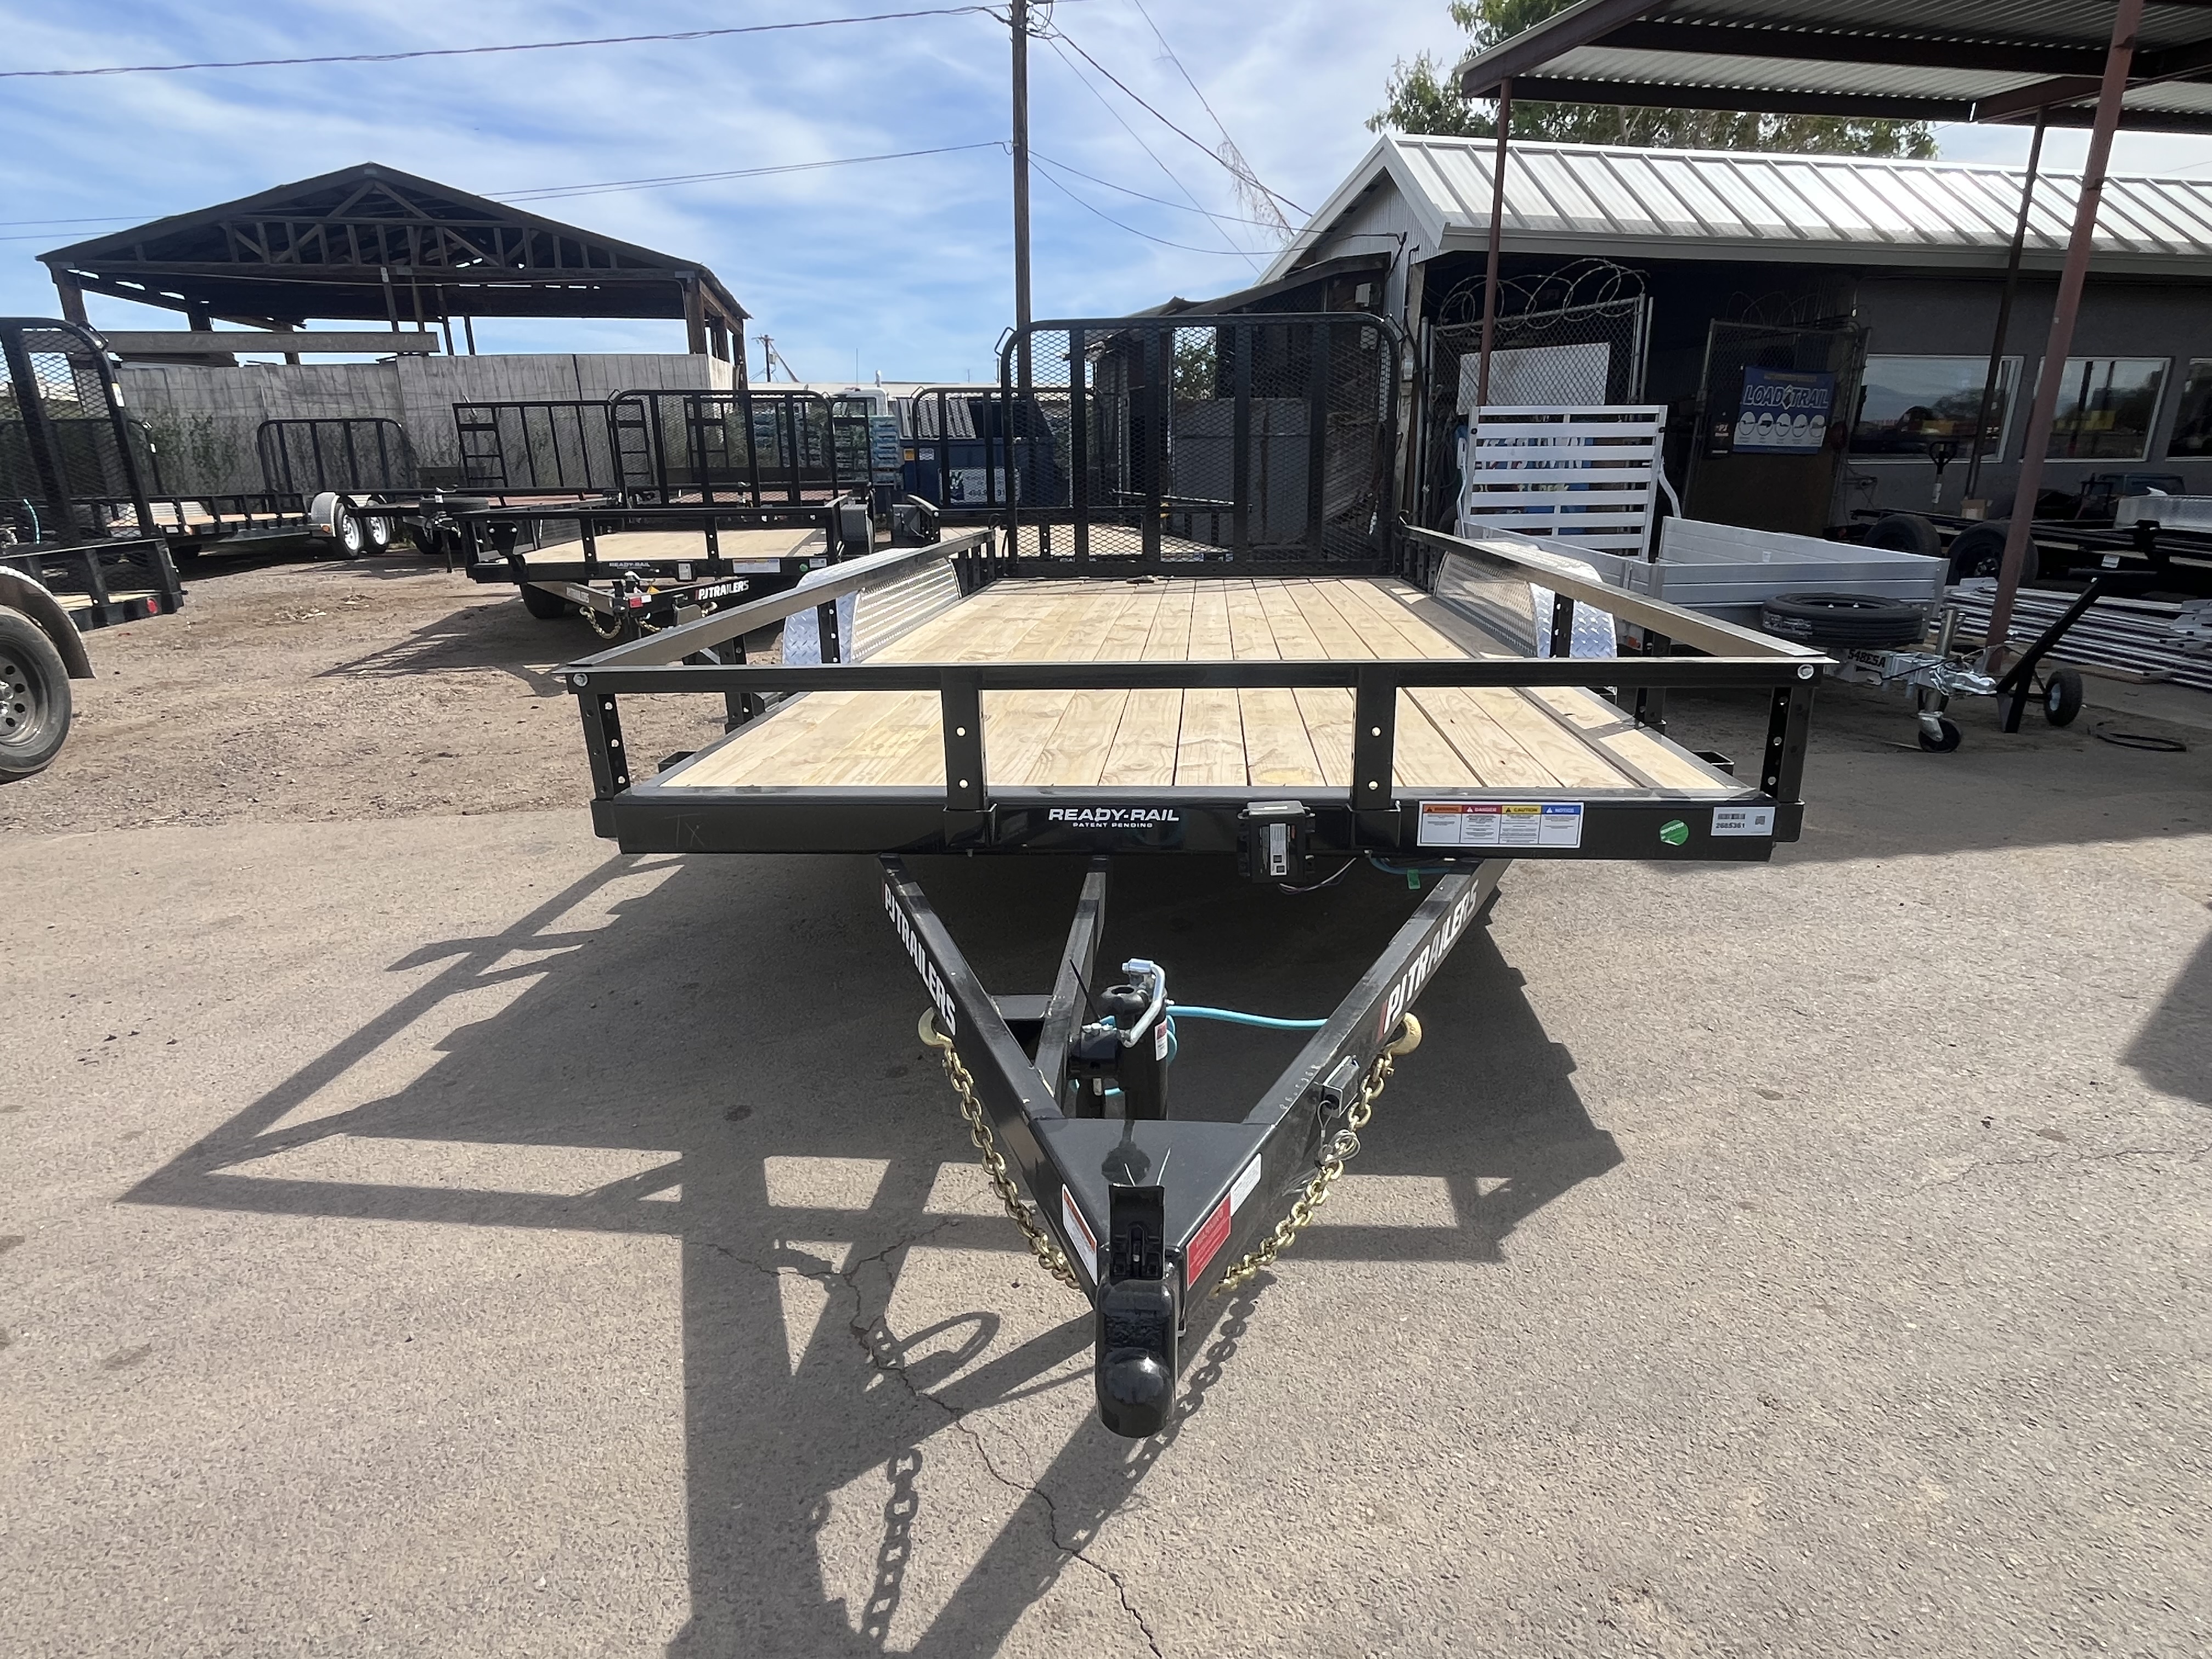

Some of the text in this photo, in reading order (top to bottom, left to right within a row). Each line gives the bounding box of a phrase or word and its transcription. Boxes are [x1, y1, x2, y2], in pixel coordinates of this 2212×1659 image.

[1743, 385, 1829, 409] LOAD TRAIL
[1048, 808, 1180, 822] READY-RAIL
